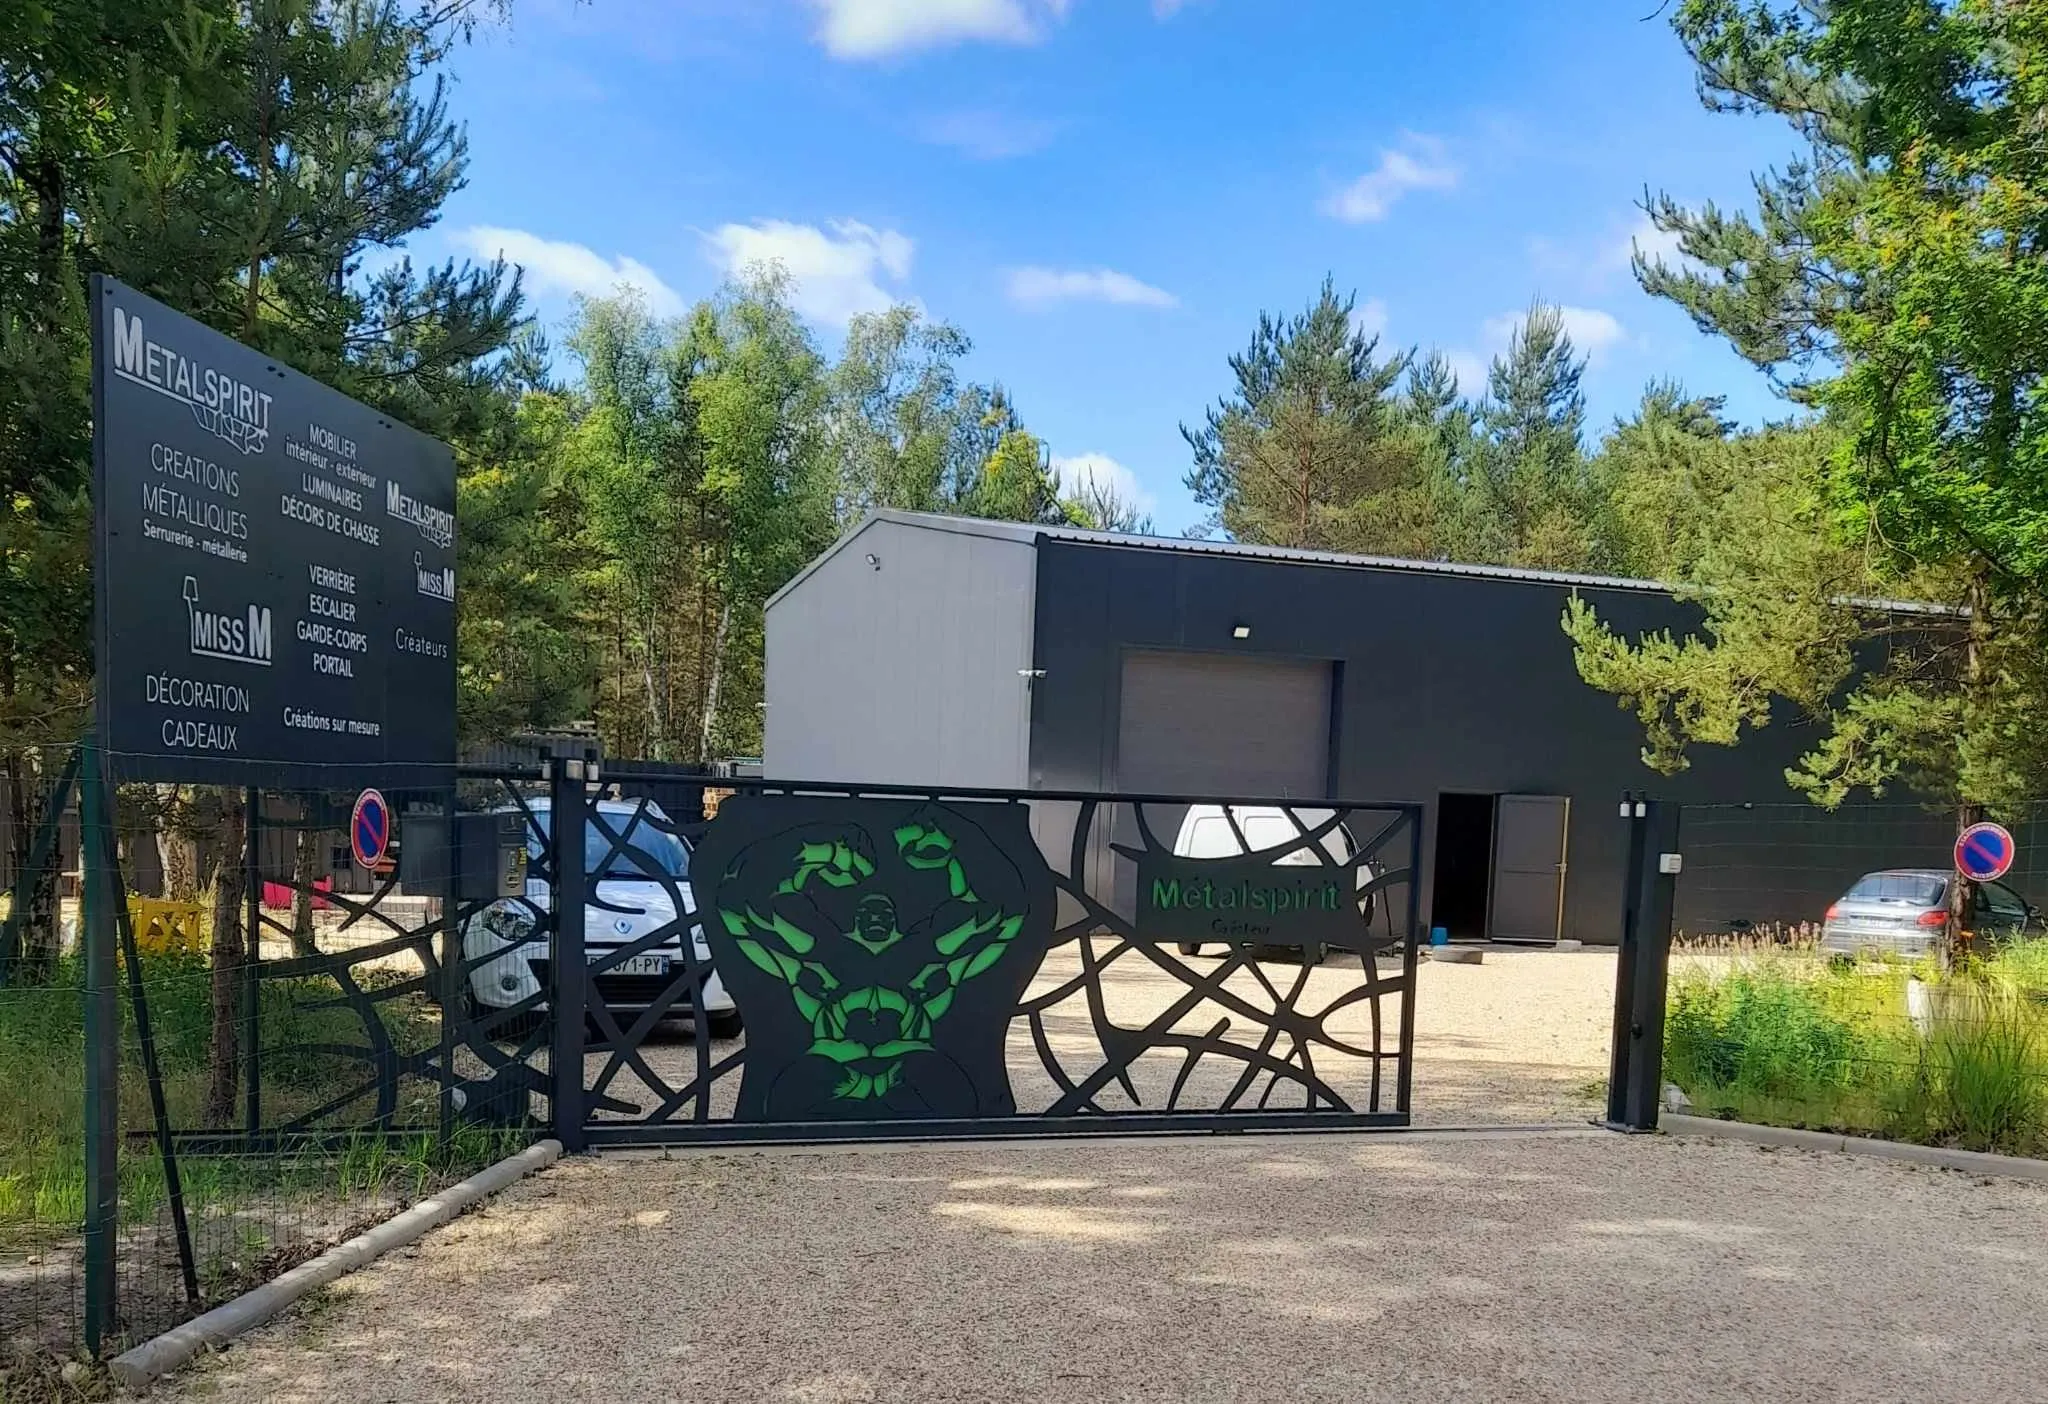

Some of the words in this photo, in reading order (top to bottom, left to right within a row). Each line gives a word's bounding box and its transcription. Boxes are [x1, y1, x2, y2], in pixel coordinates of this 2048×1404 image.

[113, 307, 273, 430] METALSPIRIT
[309, 423, 357, 460] MOBILIER
[151, 443, 239, 497] CREATIONS
[285, 435, 328, 470] intérieur
[335, 462, 377, 489] extérieur
[143, 481, 248, 540] MÉTALLIQUES
[302, 472, 362, 511] LUMINAIRES
[387, 479, 455, 537] METALSPIRIT
[281, 493, 325, 528] DÉCORS
[326, 511, 341, 533] DE
[342, 517, 380, 546] CHASSE
[143, 518, 194, 548] Serrurerie
[202, 538, 248, 563] métallerie
[309, 564, 357, 595] VERRIÈRE
[419, 571, 442, 595] MISS
[443, 567, 455, 598] M
[310, 593, 356, 623] ESCALIER
[195, 610, 245, 654] MISS
[249, 604, 272, 660] M
[297, 620, 368, 653] GARDE-CORPS
[395, 627, 448, 659] Créateurs
[313, 652, 354, 678] PORTAIL
[146, 670, 250, 713] DÉCORATION
[162, 719, 238, 751] CADEAUX
[283, 706, 331, 732] Créations
[332, 718, 347, 733] sur
[348, 720, 381, 737] mesure
